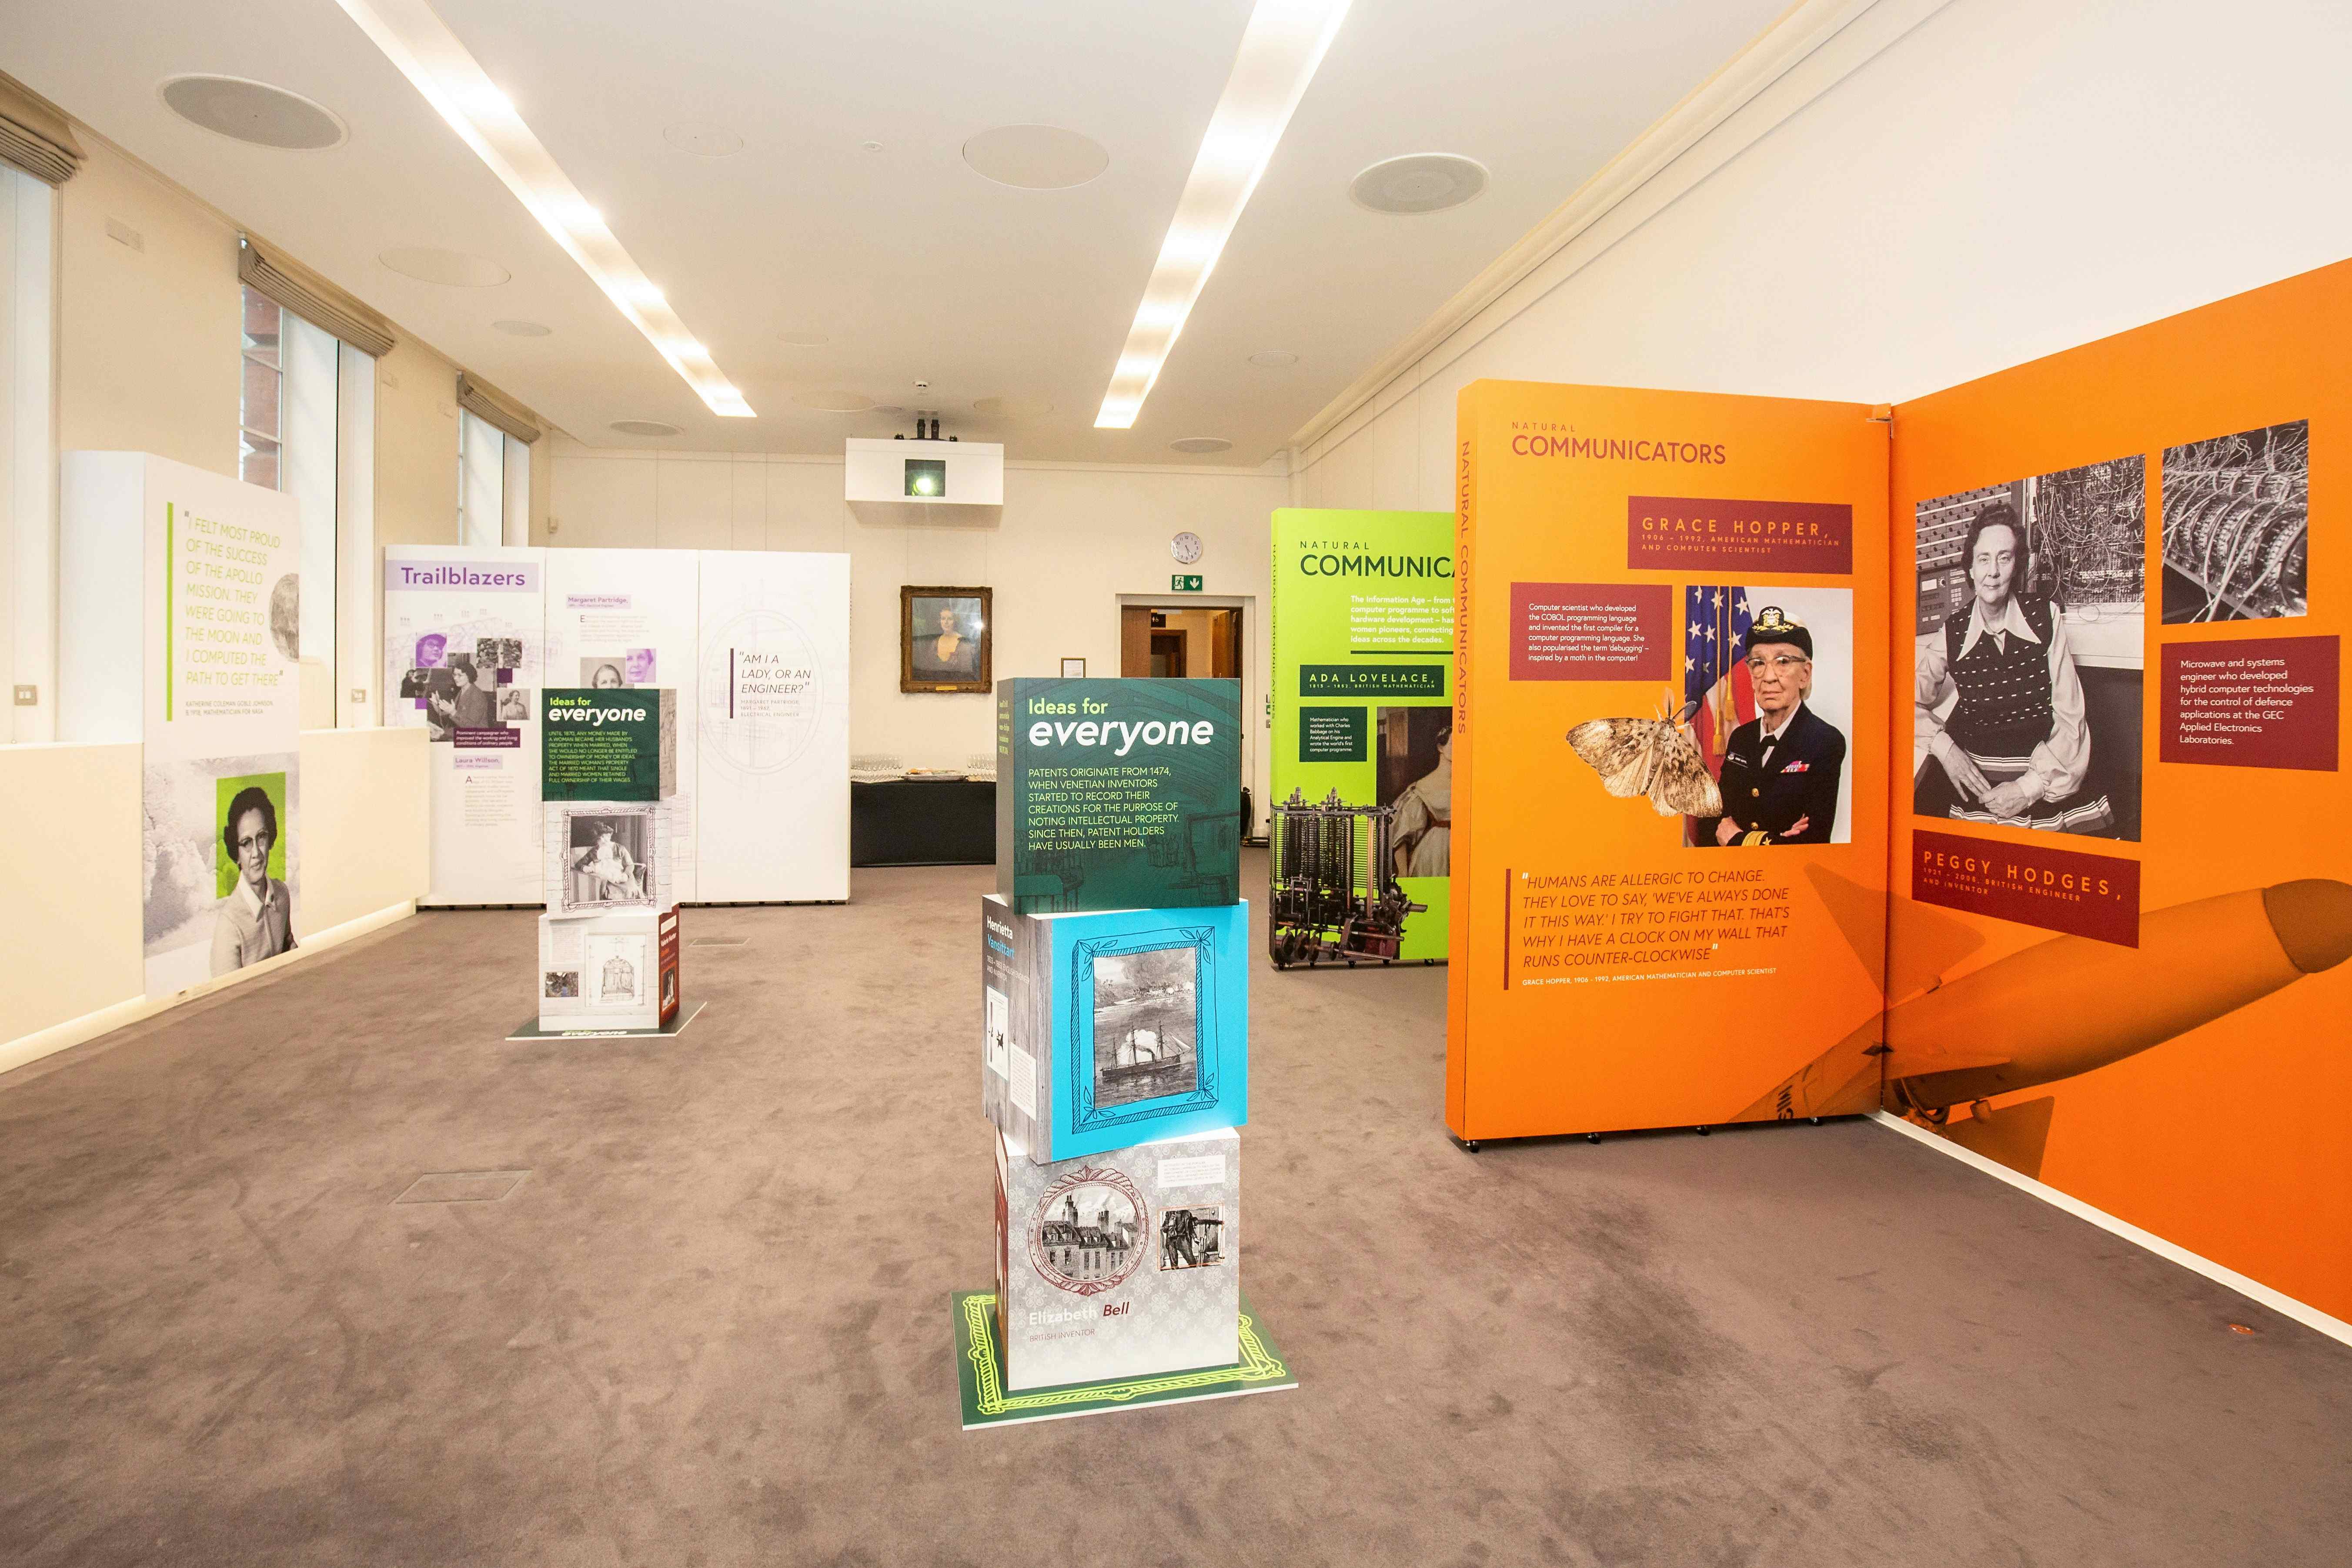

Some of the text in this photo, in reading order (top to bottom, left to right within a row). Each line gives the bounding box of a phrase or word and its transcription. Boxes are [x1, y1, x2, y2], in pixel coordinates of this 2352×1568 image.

[1512, 421, 1576, 432] NATURAL
[1512, 435, 1726, 465] COMMUNICATORS
[195, 518, 217, 534] FELT
[220, 524, 248, 541] MOST
[250, 530, 281, 548] PROUD
[1642, 517, 1828, 539] GRACE HOPPER,
[187, 538, 267, 566] OF THE SUCCESS
[1300, 541, 1370, 550] NATURAL
[1666, 544, 1717, 552] COMPUTER
[187, 561, 262, 585] OF THE APOLLO
[1300, 555, 1455, 578] COMMUNIC
[401, 567, 525, 585] Trailblazers
[1458, 441, 1470, 735] NATURAL COMMUNICATORS
[236, 589, 257, 604] THEY
[186, 605, 264, 625] WERE GOING TO
[1529, 603, 1561, 612] Computer
[1589, 603, 1604, 612] who
[1604, 604, 1637, 613] developed
[1567, 615, 1608, 624] programming
[1608, 614, 1637, 624] language
[186, 627, 262, 645] THE MOON AND
[1414, 626, 1453, 635] connecting
[186, 649, 267, 665] I COMPUTED THE
[765, 655, 768, 663] I
[771, 655, 778, 663] A
[2180, 658, 2285, 669] Microwave and systems
[187, 671, 211, 685] PATH
[216, 672, 228, 685] TO
[231, 672, 249, 685] GET
[742, 669, 811, 680] LADY, OR AN
[1309, 673, 1434, 684] ADA LOVELACE,
[2180, 669, 2288, 683] engineer who developed
[2180, 683, 2315, 695] hybrid computer technologies
[550, 697, 591, 705] Ideas for
[1029, 697, 1109, 715] Ideas for
[2180, 696, 2293, 708] for the control of defence
[548, 708, 646, 726] everyone
[2179, 710, 2285, 720] applications at the GEC
[2179, 722, 2263, 733] Applied Electronics
[1029, 720, 1214, 756] everyone
[2179, 734, 2235, 746] Laboratories.
[1028, 766, 1172, 779] PATENTS ORIGINATE FROM 1474,
[1028, 778, 1158, 790] WHEN VENETIAN INVENTORS
[1028, 790, 1150, 802] STARTED TO RECORD THEIR
[1028, 802, 1179, 814] CREATIONS FOR THE PURPOSE OF
[1028, 813, 1179, 827] NOTING INTELLECTUAL PROPERTY.
[1028, 826, 1165, 839] SINCE THEN, PATENT HOLDERS
[1028, 839, 1146, 851] HAVE USUALLY BEEN MEN.
[1522, 869, 1765, 889] "HUMANS ARE ALLERGIC TO CHANGE.
[1924, 850, 2121, 901] PEGGY HODGES,
[987, 915, 1013, 939] Henrietta
[988, 934, 1015, 960] Vansittart
[1523, 943, 1718, 968] RUNS COUNTER-CLOCKWISE"
[1029, 1301, 1129, 1326] Elizabeth Bell
[1029, 1328, 1096, 1342] BRITISH INVENTOR
